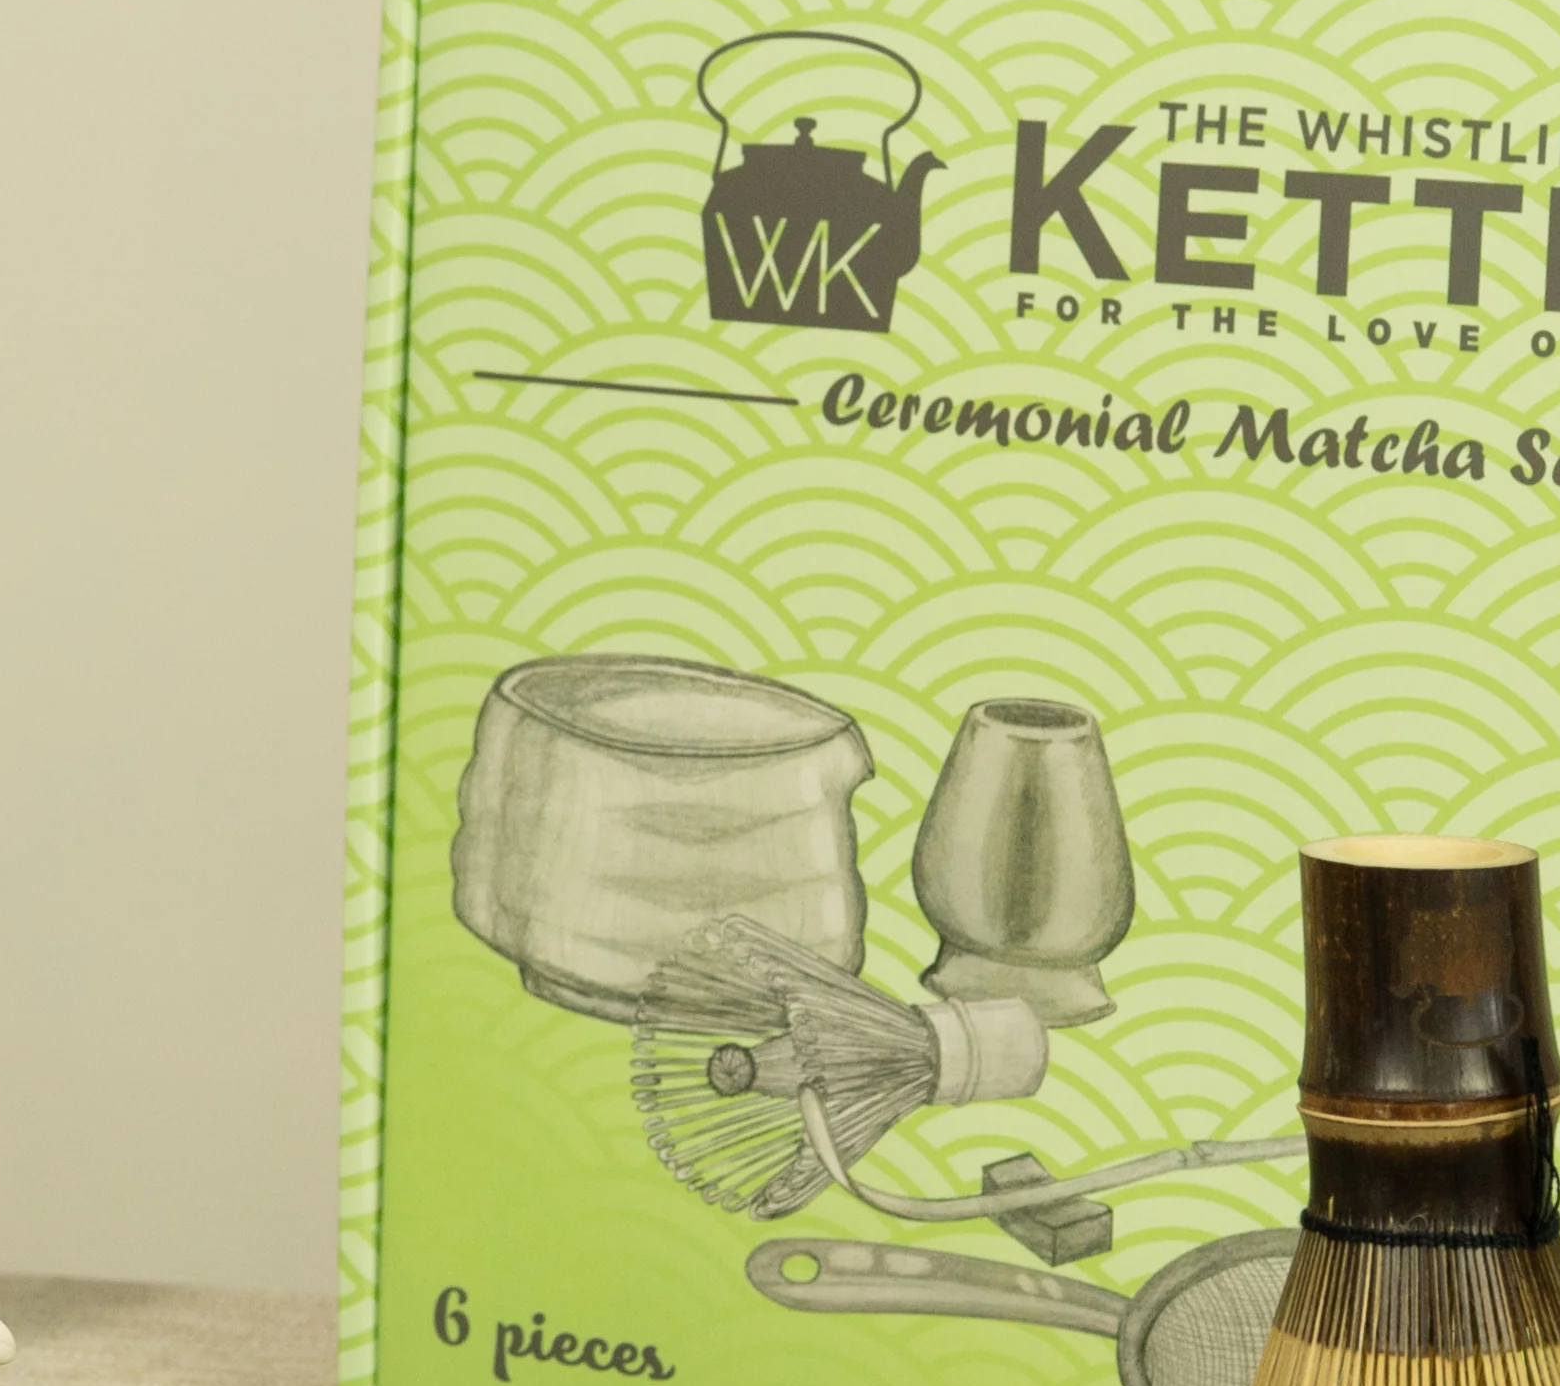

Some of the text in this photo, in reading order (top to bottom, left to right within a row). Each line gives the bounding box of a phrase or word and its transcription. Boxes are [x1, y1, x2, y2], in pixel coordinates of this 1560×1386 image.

[1159, 101, 1268, 148] THE
[716, 212, 882, 318] WK
[1016, 292, 1123, 326] FOR
[1171, 303, 1278, 338] THE
[1326, 314, 1480, 353] LOVE
[822, 373, 1191, 453] Ceremonial
[1213, 403, 1485, 481] Matcha
[433, 1286, 676, 1383] 6 pieces
